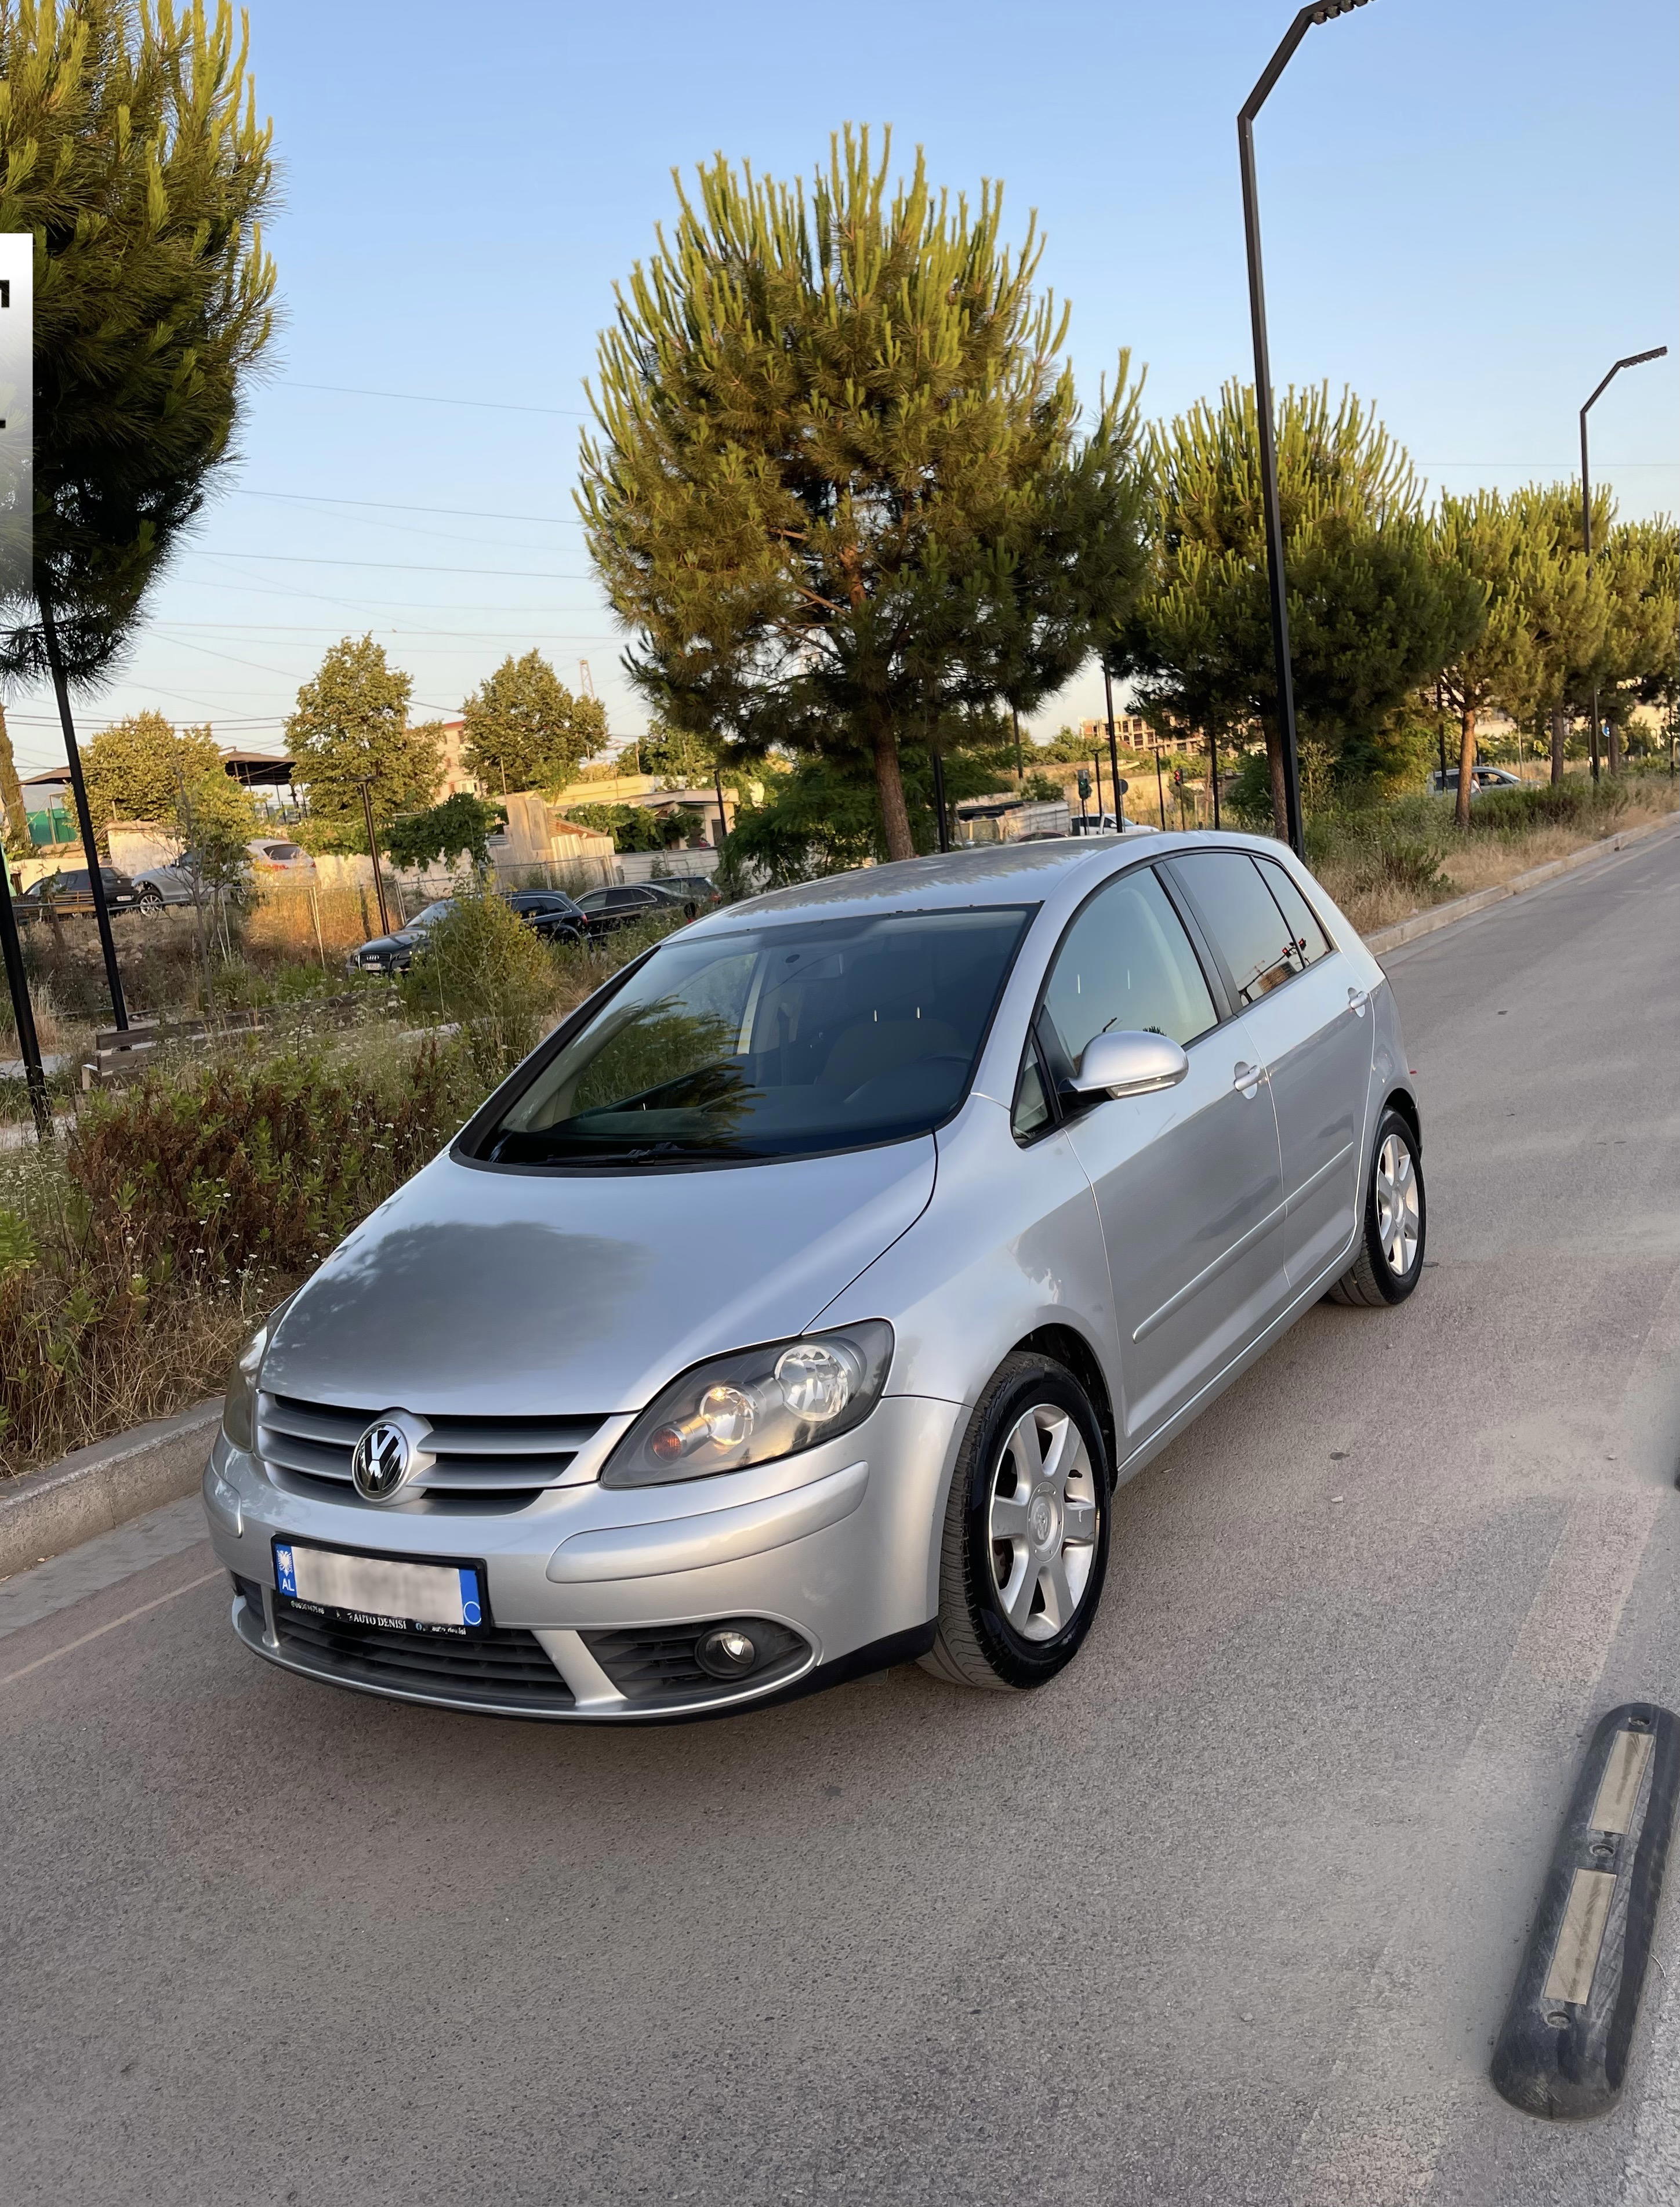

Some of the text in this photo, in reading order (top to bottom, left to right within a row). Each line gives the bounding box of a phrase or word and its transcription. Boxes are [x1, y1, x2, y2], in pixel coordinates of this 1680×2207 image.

[282, 1578, 295, 1592] AL
[354, 1614, 407, 1629] AUTO DENISI
